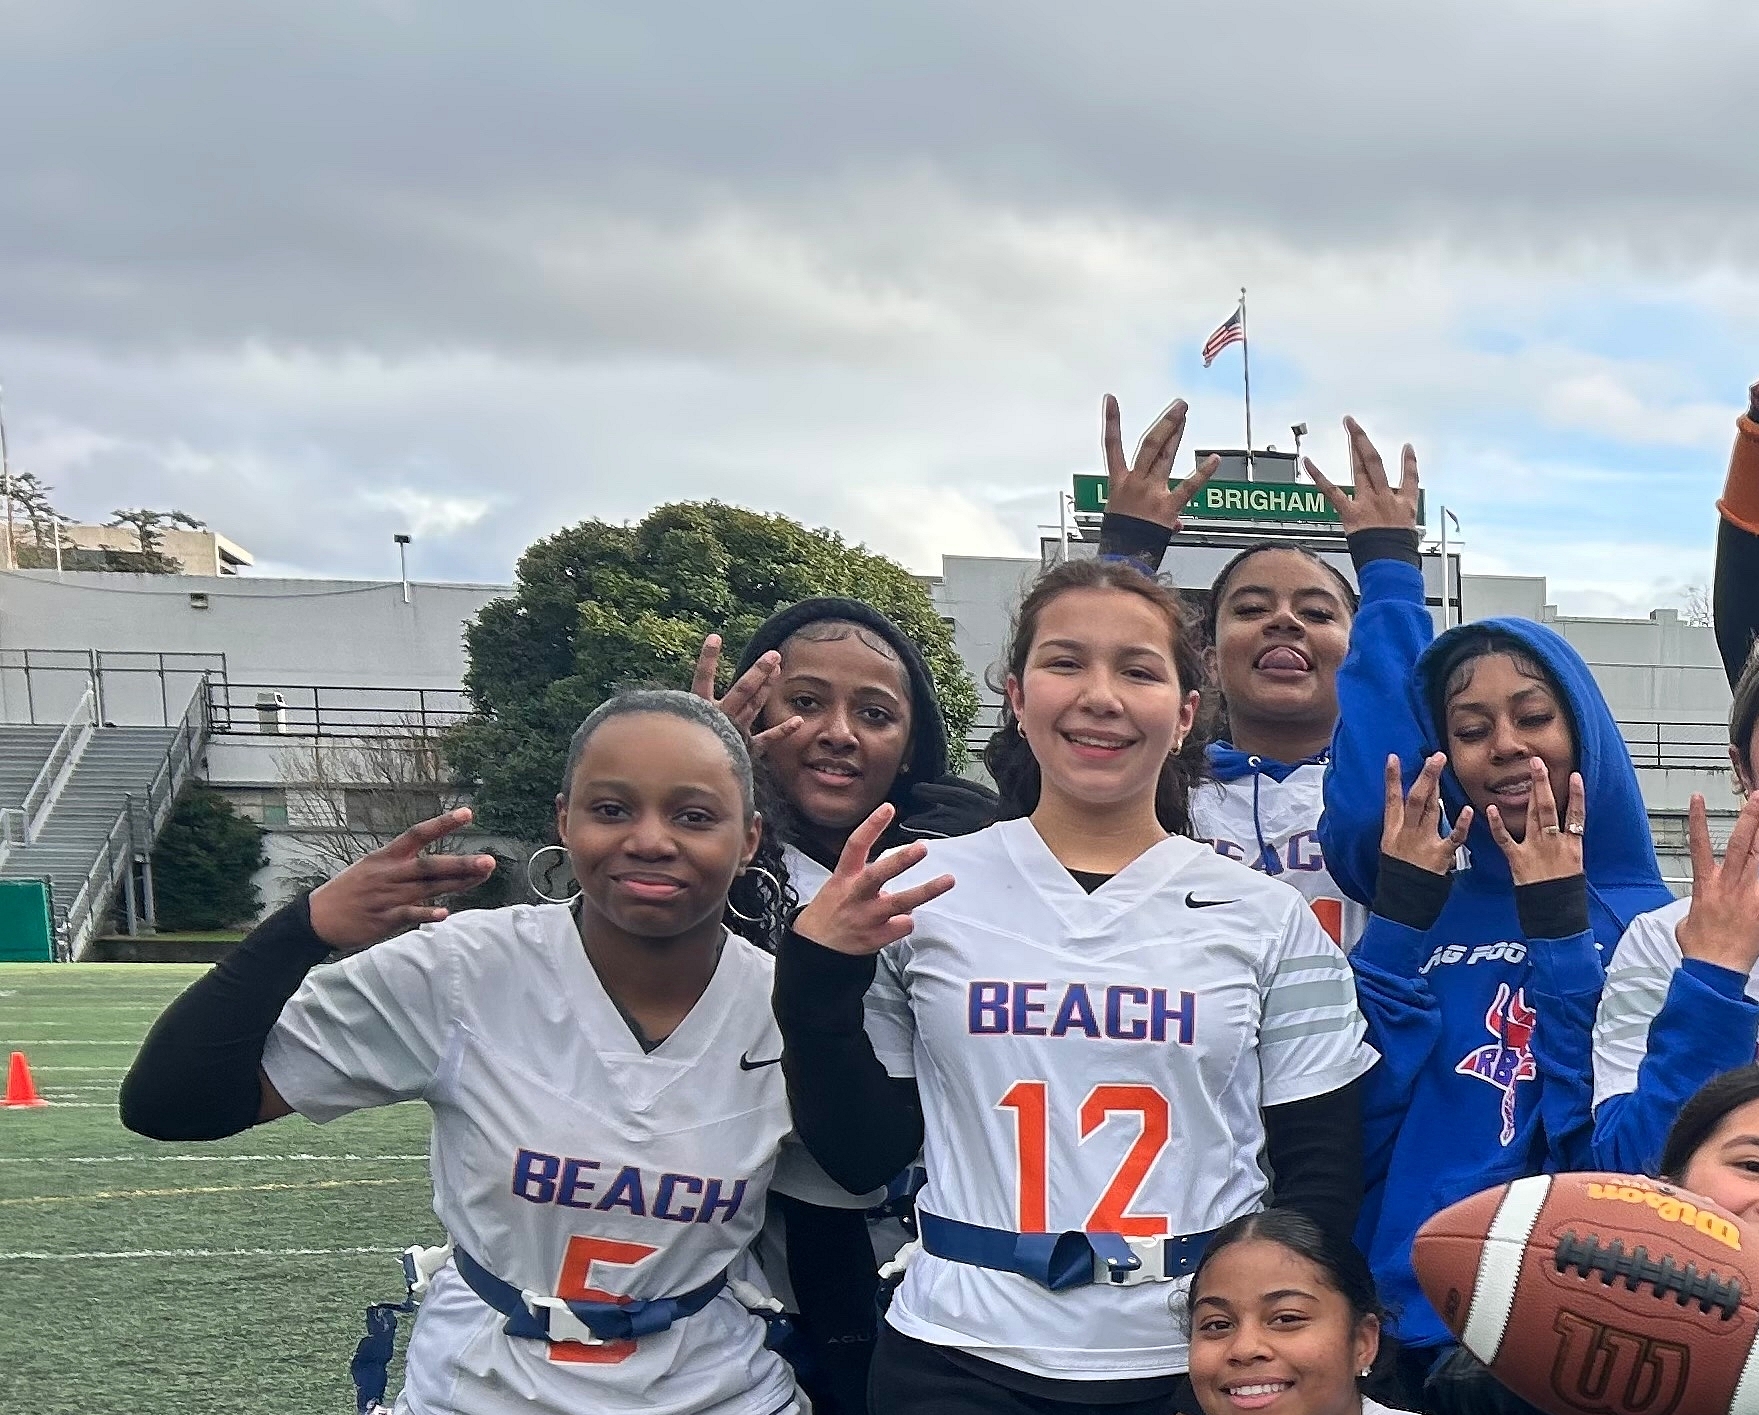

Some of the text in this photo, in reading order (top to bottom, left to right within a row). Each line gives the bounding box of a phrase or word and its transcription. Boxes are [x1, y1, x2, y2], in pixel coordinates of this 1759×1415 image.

[1206, 488, 1325, 513] BRIGHAM
[1195, 830, 1323, 876] EAC
[967, 980, 1197, 1045] BEACH
[512, 1147, 749, 1225] BEACH
[994, 1079, 1173, 1237] 12
[1588, 1182, 1742, 1251] Wilson
